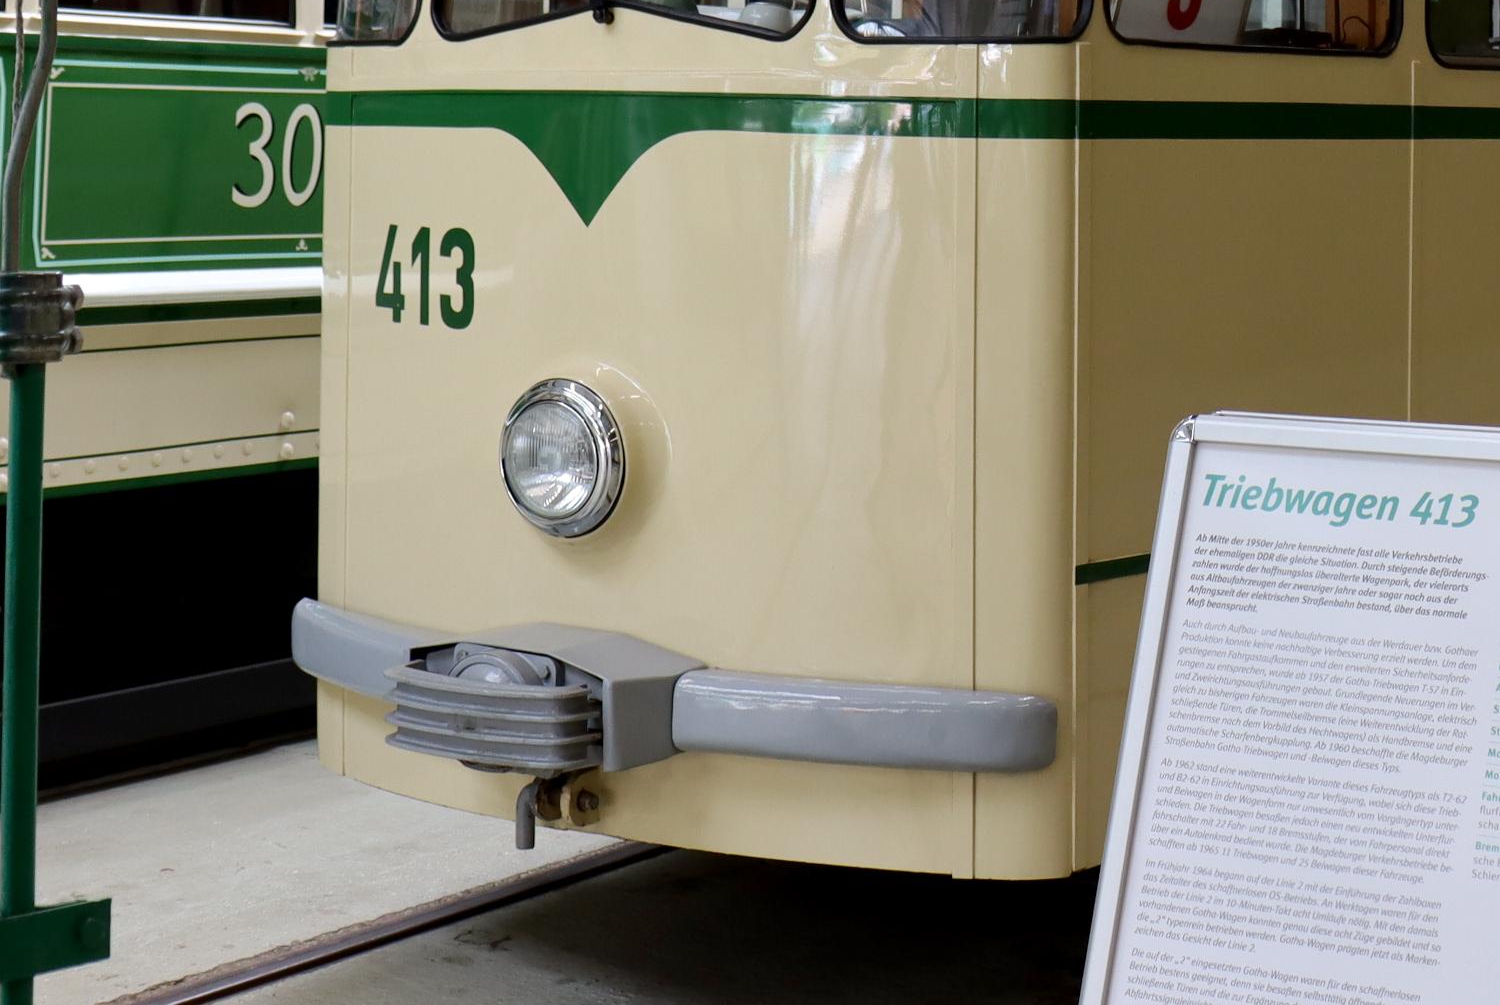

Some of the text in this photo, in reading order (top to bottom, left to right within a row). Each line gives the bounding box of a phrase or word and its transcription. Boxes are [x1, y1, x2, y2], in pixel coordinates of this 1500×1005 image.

[231, 102, 323, 208] 30
[375, 224, 475, 330] 413
[1202, 474, 1480, 528] Triebwagen 413
[1194, 546, 1489, 581] der ehemaligen DDR die gleiche Situation. Durch steigende Beförderungs-
[1195, 533, 1464, 564] Ab Mitte der 1950er Jahre kennzeichnete fast alle Verkehrsbetriebe
[1192, 559, 1469, 592] zahlen wurde der hoffnungslos überalterte Wagenpark, der vielerorts
[1205, 574, 1277, 589] Altbaufahrzeugen
[1277, 580, 1292, 590] der
[1291, 583, 1335, 594] zwanziger
[1333, 585, 1358, 596] Jahre
[1357, 587, 1378, 598] oder
[1378, 591, 1404, 601] sogar
[1403, 592, 1426, 602] noch
[1425, 595, 1443, 604] aus
[1443, 594, 1459, 605] der
[1186, 597, 1258, 612] Maß beansprucht.
[1187, 585, 1468, 620] Anfangszeit der elektrischen Straßenbahn bestand, über das normale
[1473, 856, 1495, 867] sche
